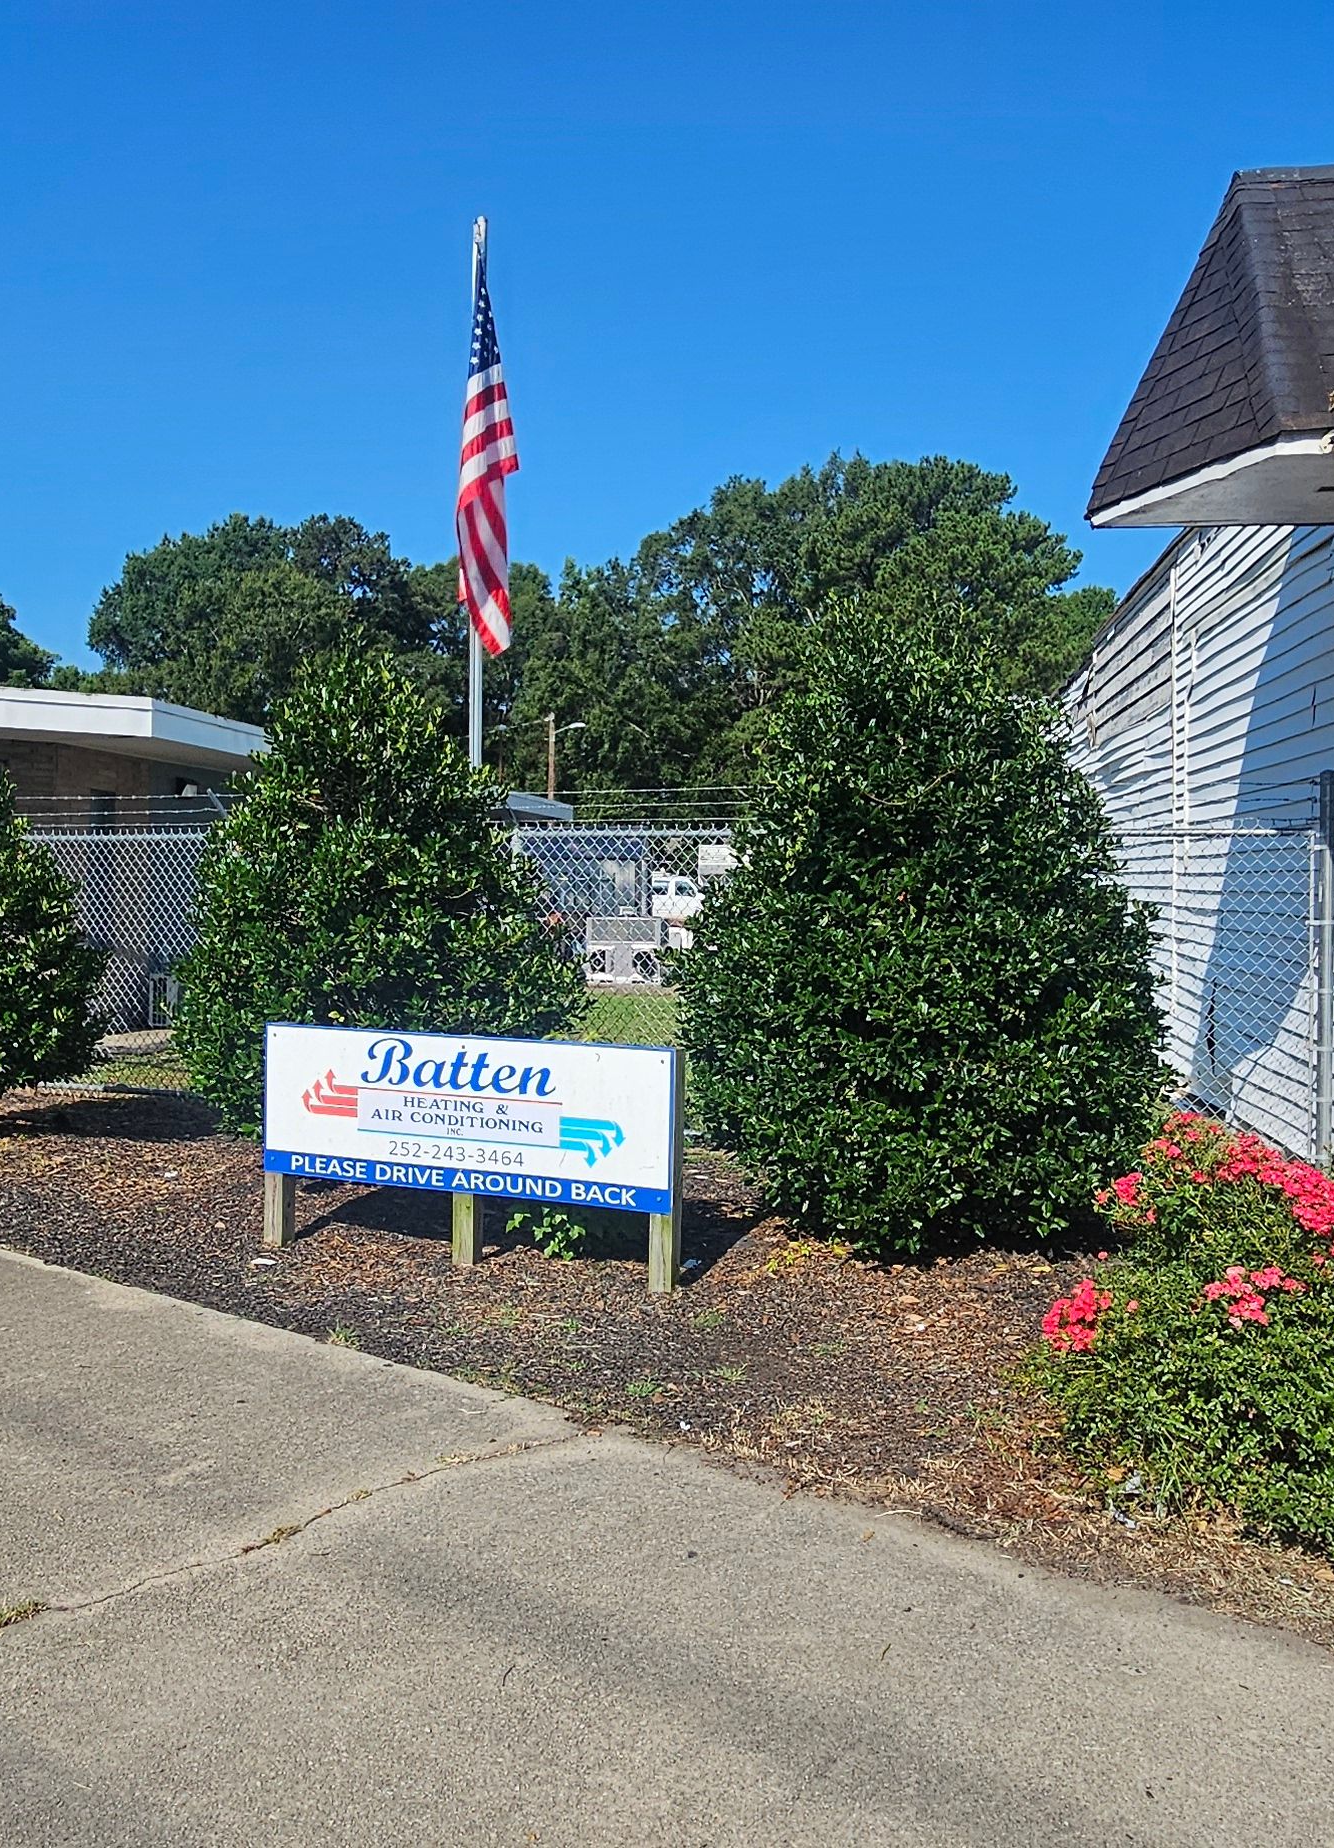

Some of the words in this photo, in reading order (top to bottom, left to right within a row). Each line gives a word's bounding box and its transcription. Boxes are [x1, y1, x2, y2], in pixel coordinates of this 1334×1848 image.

[361, 1037, 556, 1097] Batten
[403, 1095, 485, 1114] HEATING
[495, 1103, 509, 1115] &
[371, 1108, 403, 1122] AIR
[410, 1111, 544, 1134] CONDITIONING
[446, 1127, 464, 1137] INC.
[388, 1140, 525, 1168] 252-243-3464
[290, 1155, 368, 1179] PLEASE
[375, 1164, 445, 1187] DRIVE
[451, 1170, 562, 1198] AROUND
[570, 1183, 637, 1207] BACK
